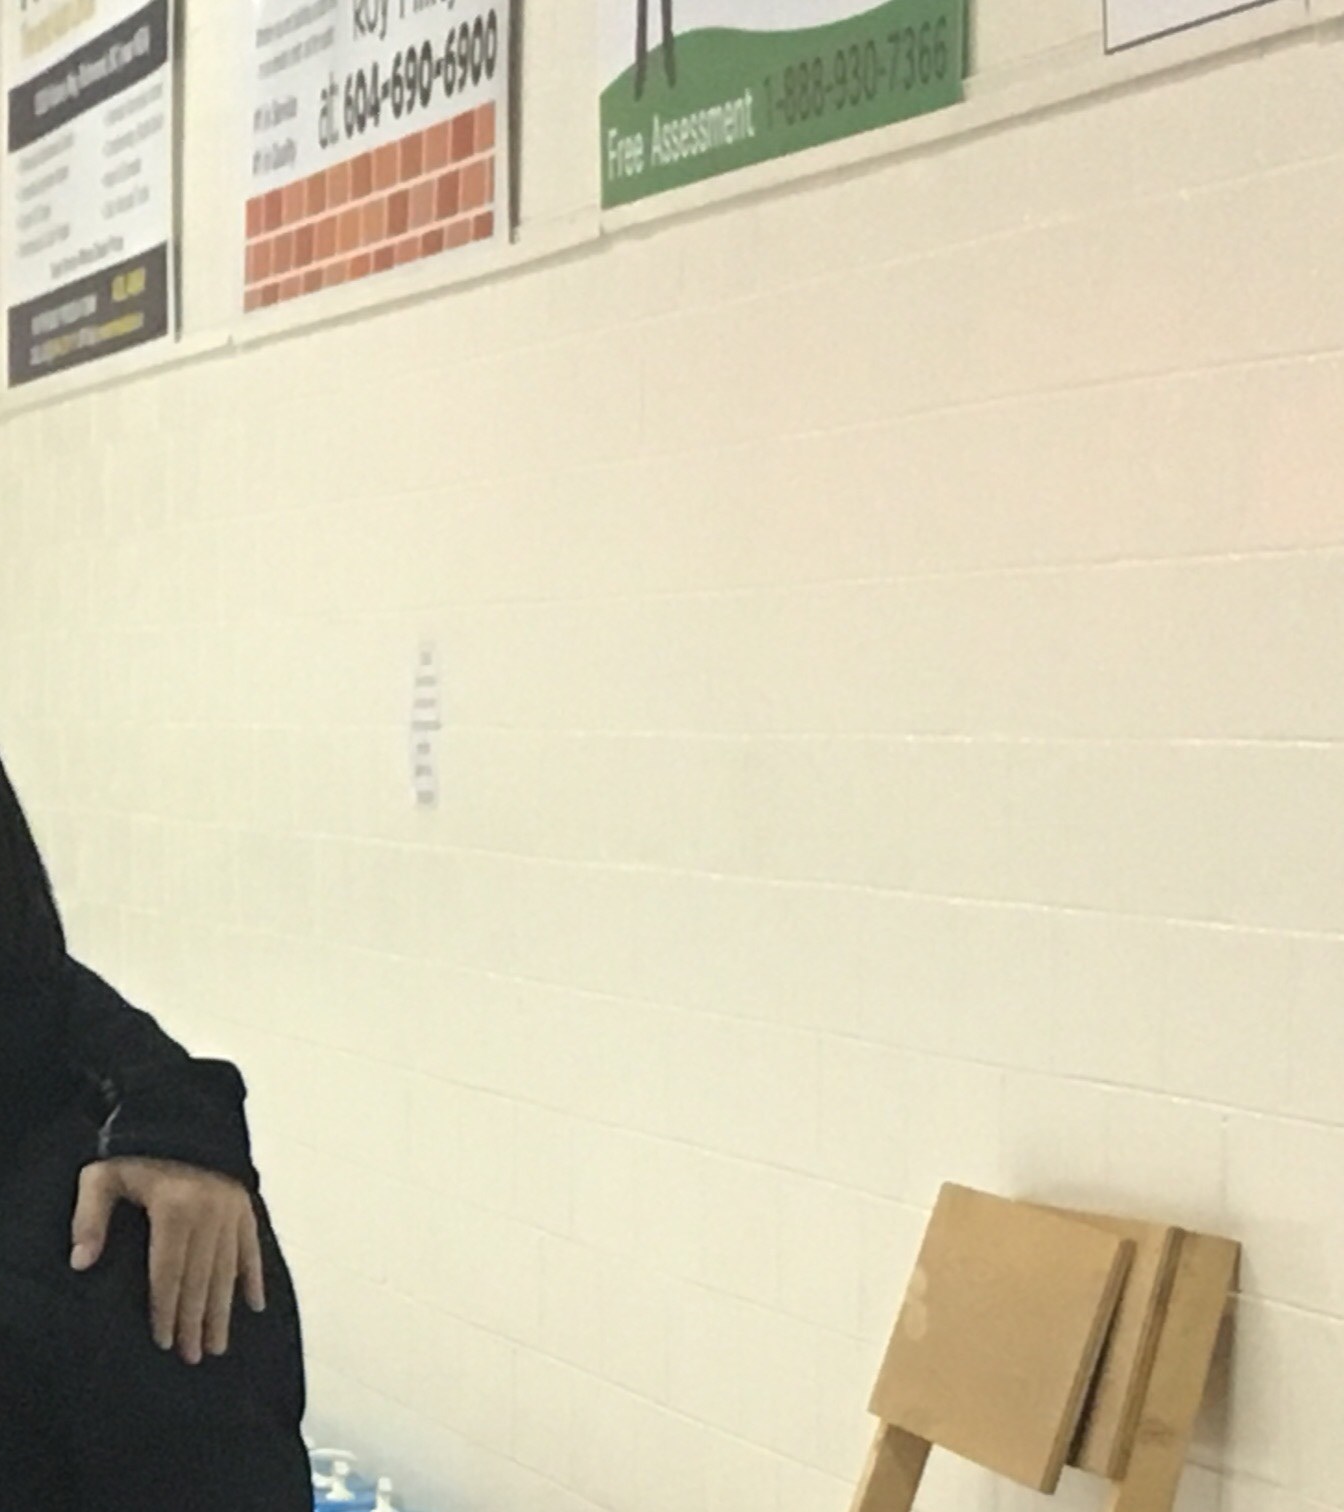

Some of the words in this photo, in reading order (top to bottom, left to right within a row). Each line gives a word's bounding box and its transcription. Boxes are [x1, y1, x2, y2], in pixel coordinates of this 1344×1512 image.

[343, 8, 497, 139] 604-690-6900
[607, 127, 644, 181] Free
[651, 86, 755, 167] Assessment
[762, 14, 949, 132] 1-888-930-7366
